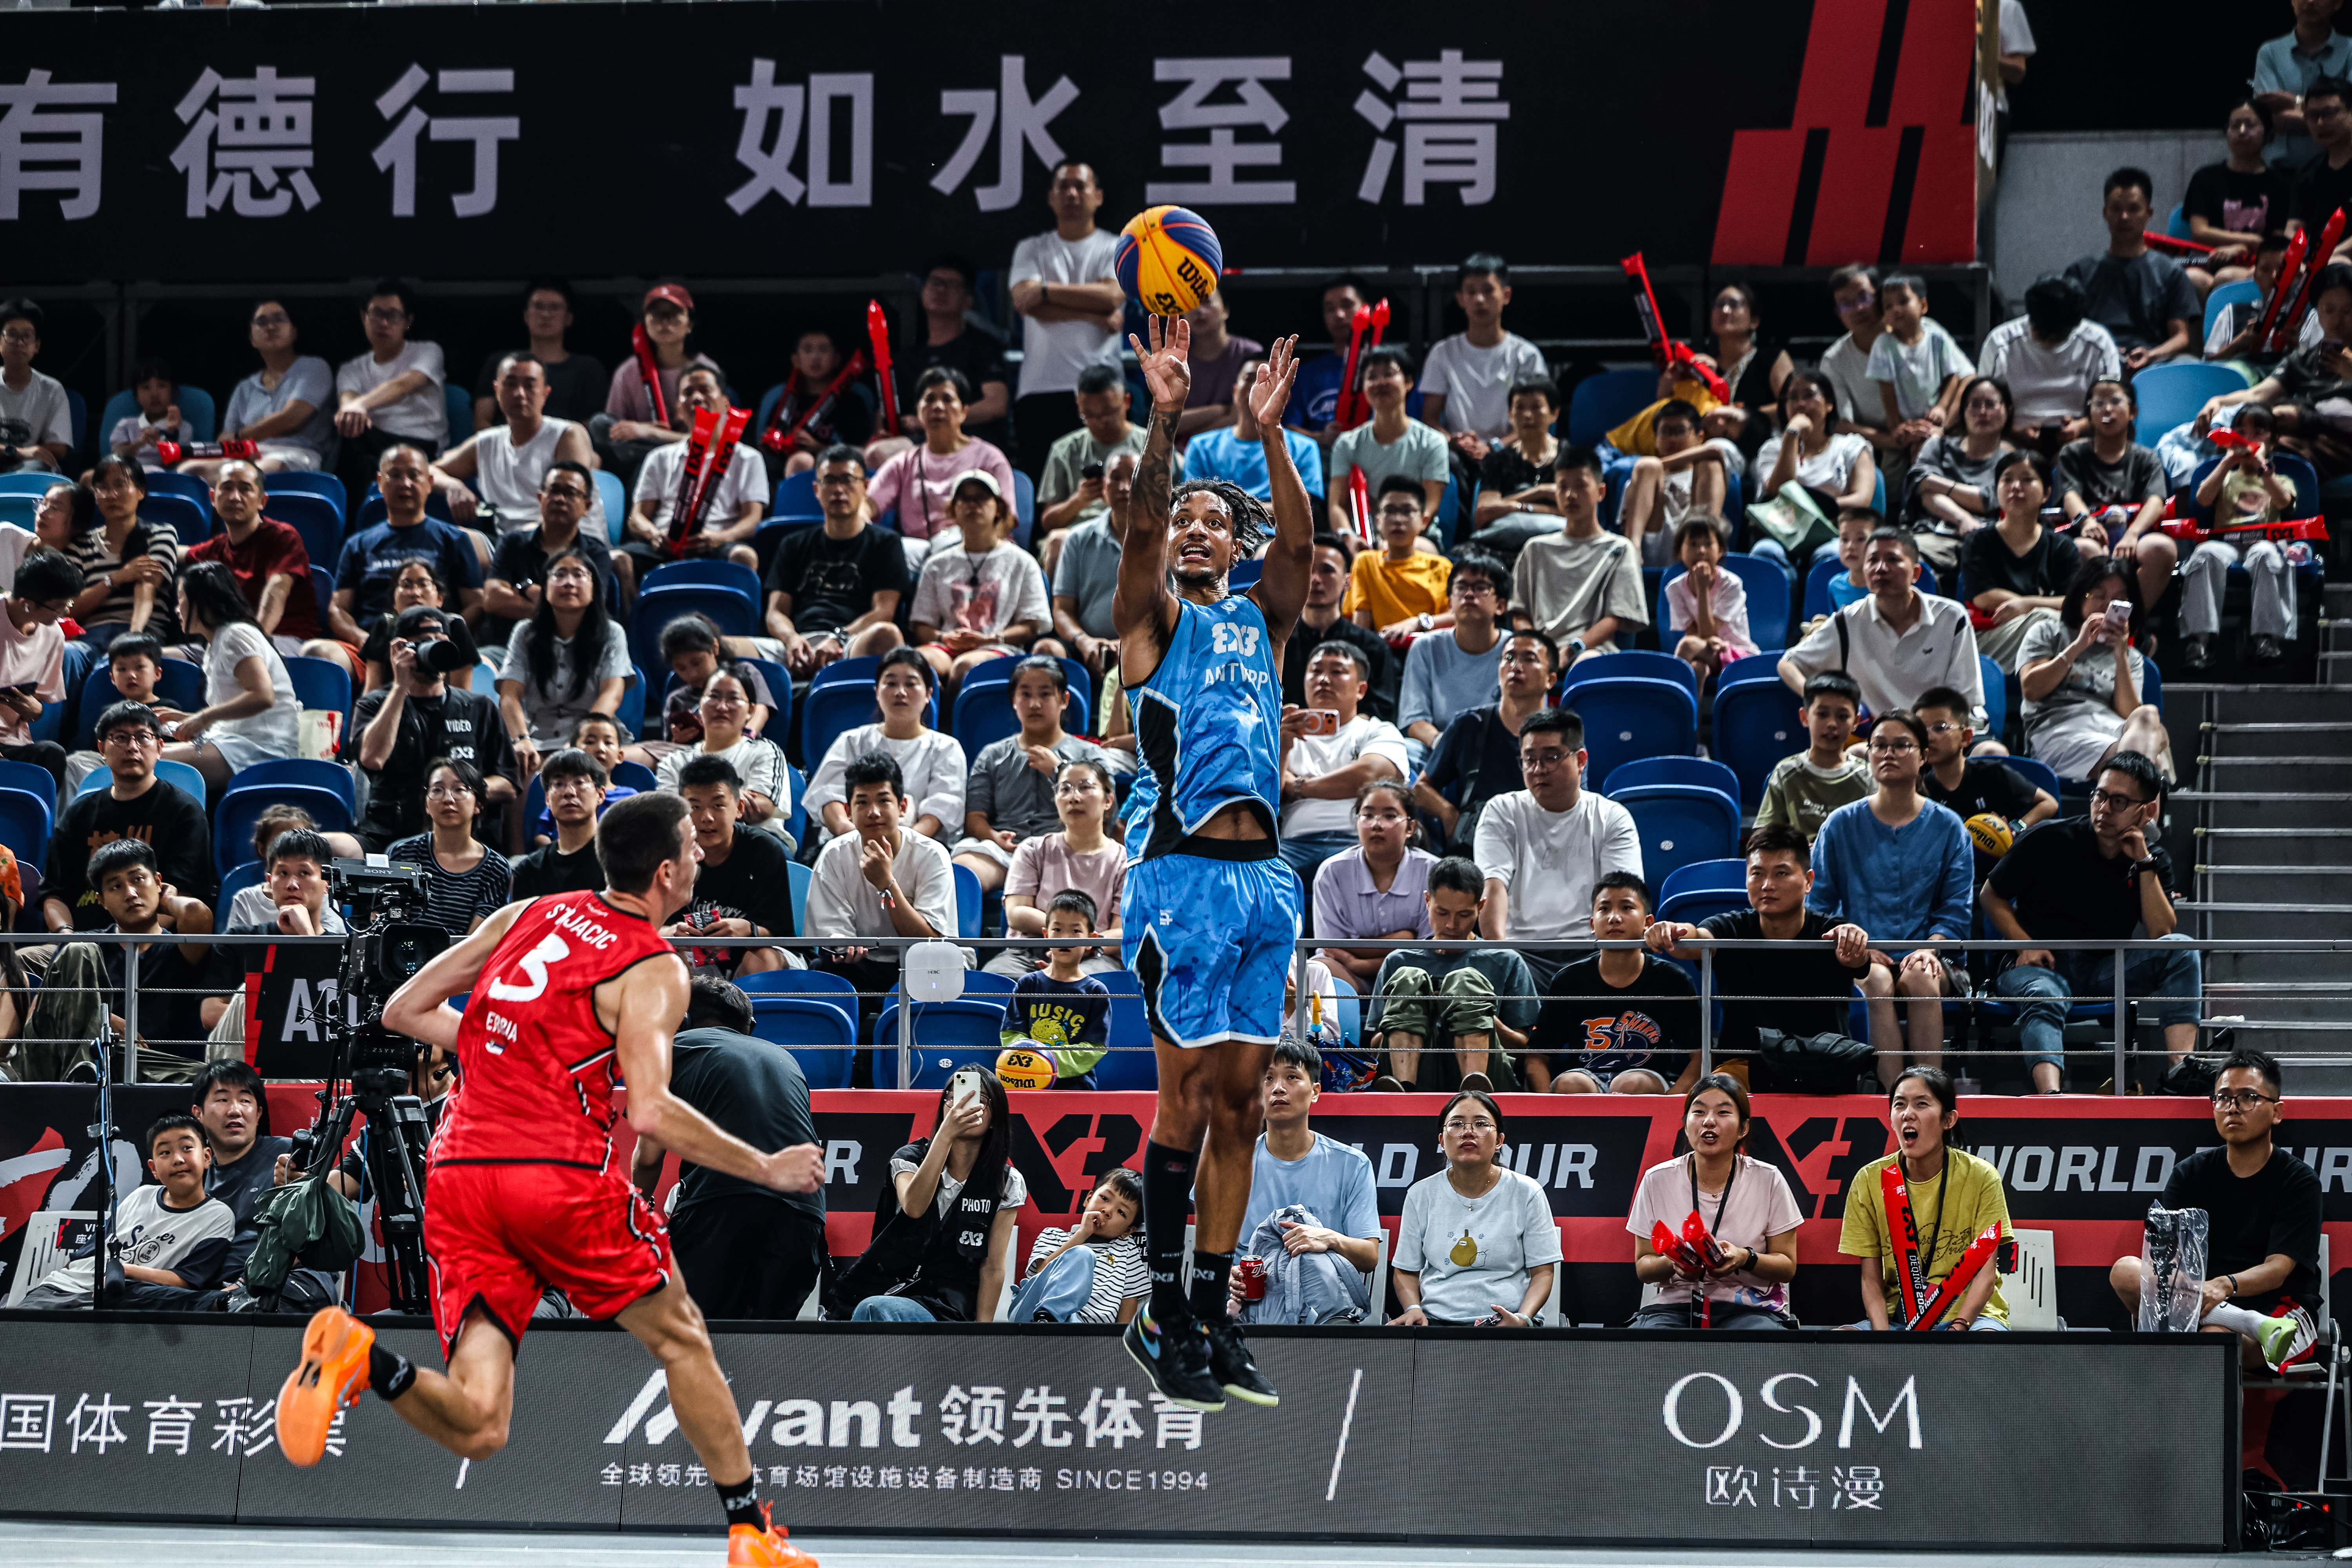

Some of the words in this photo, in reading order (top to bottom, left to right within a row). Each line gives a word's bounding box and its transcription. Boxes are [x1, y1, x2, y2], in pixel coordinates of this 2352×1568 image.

[0, 63, 520, 220] 有德行
[726, 49, 1510, 215] 如水至清
[445, 719, 472, 733] VIDEO
[487, 933, 570, 1002] 3
[999, 1073, 1036, 1088] Wilson
[961, 1198, 991, 1214] PHOTO
[75, 1234, 93, 1244] 座
[85, 1223, 98, 1232] VI
[1909, 1255, 1922, 1289] DEQING
[1920, 1287, 1940, 1315] WORLD
[940, 1385, 1205, 1450] 领先体育
[1662, 1372, 1922, 1450] OSM
[1706, 1465, 1884, 1510] 欧诗漫
